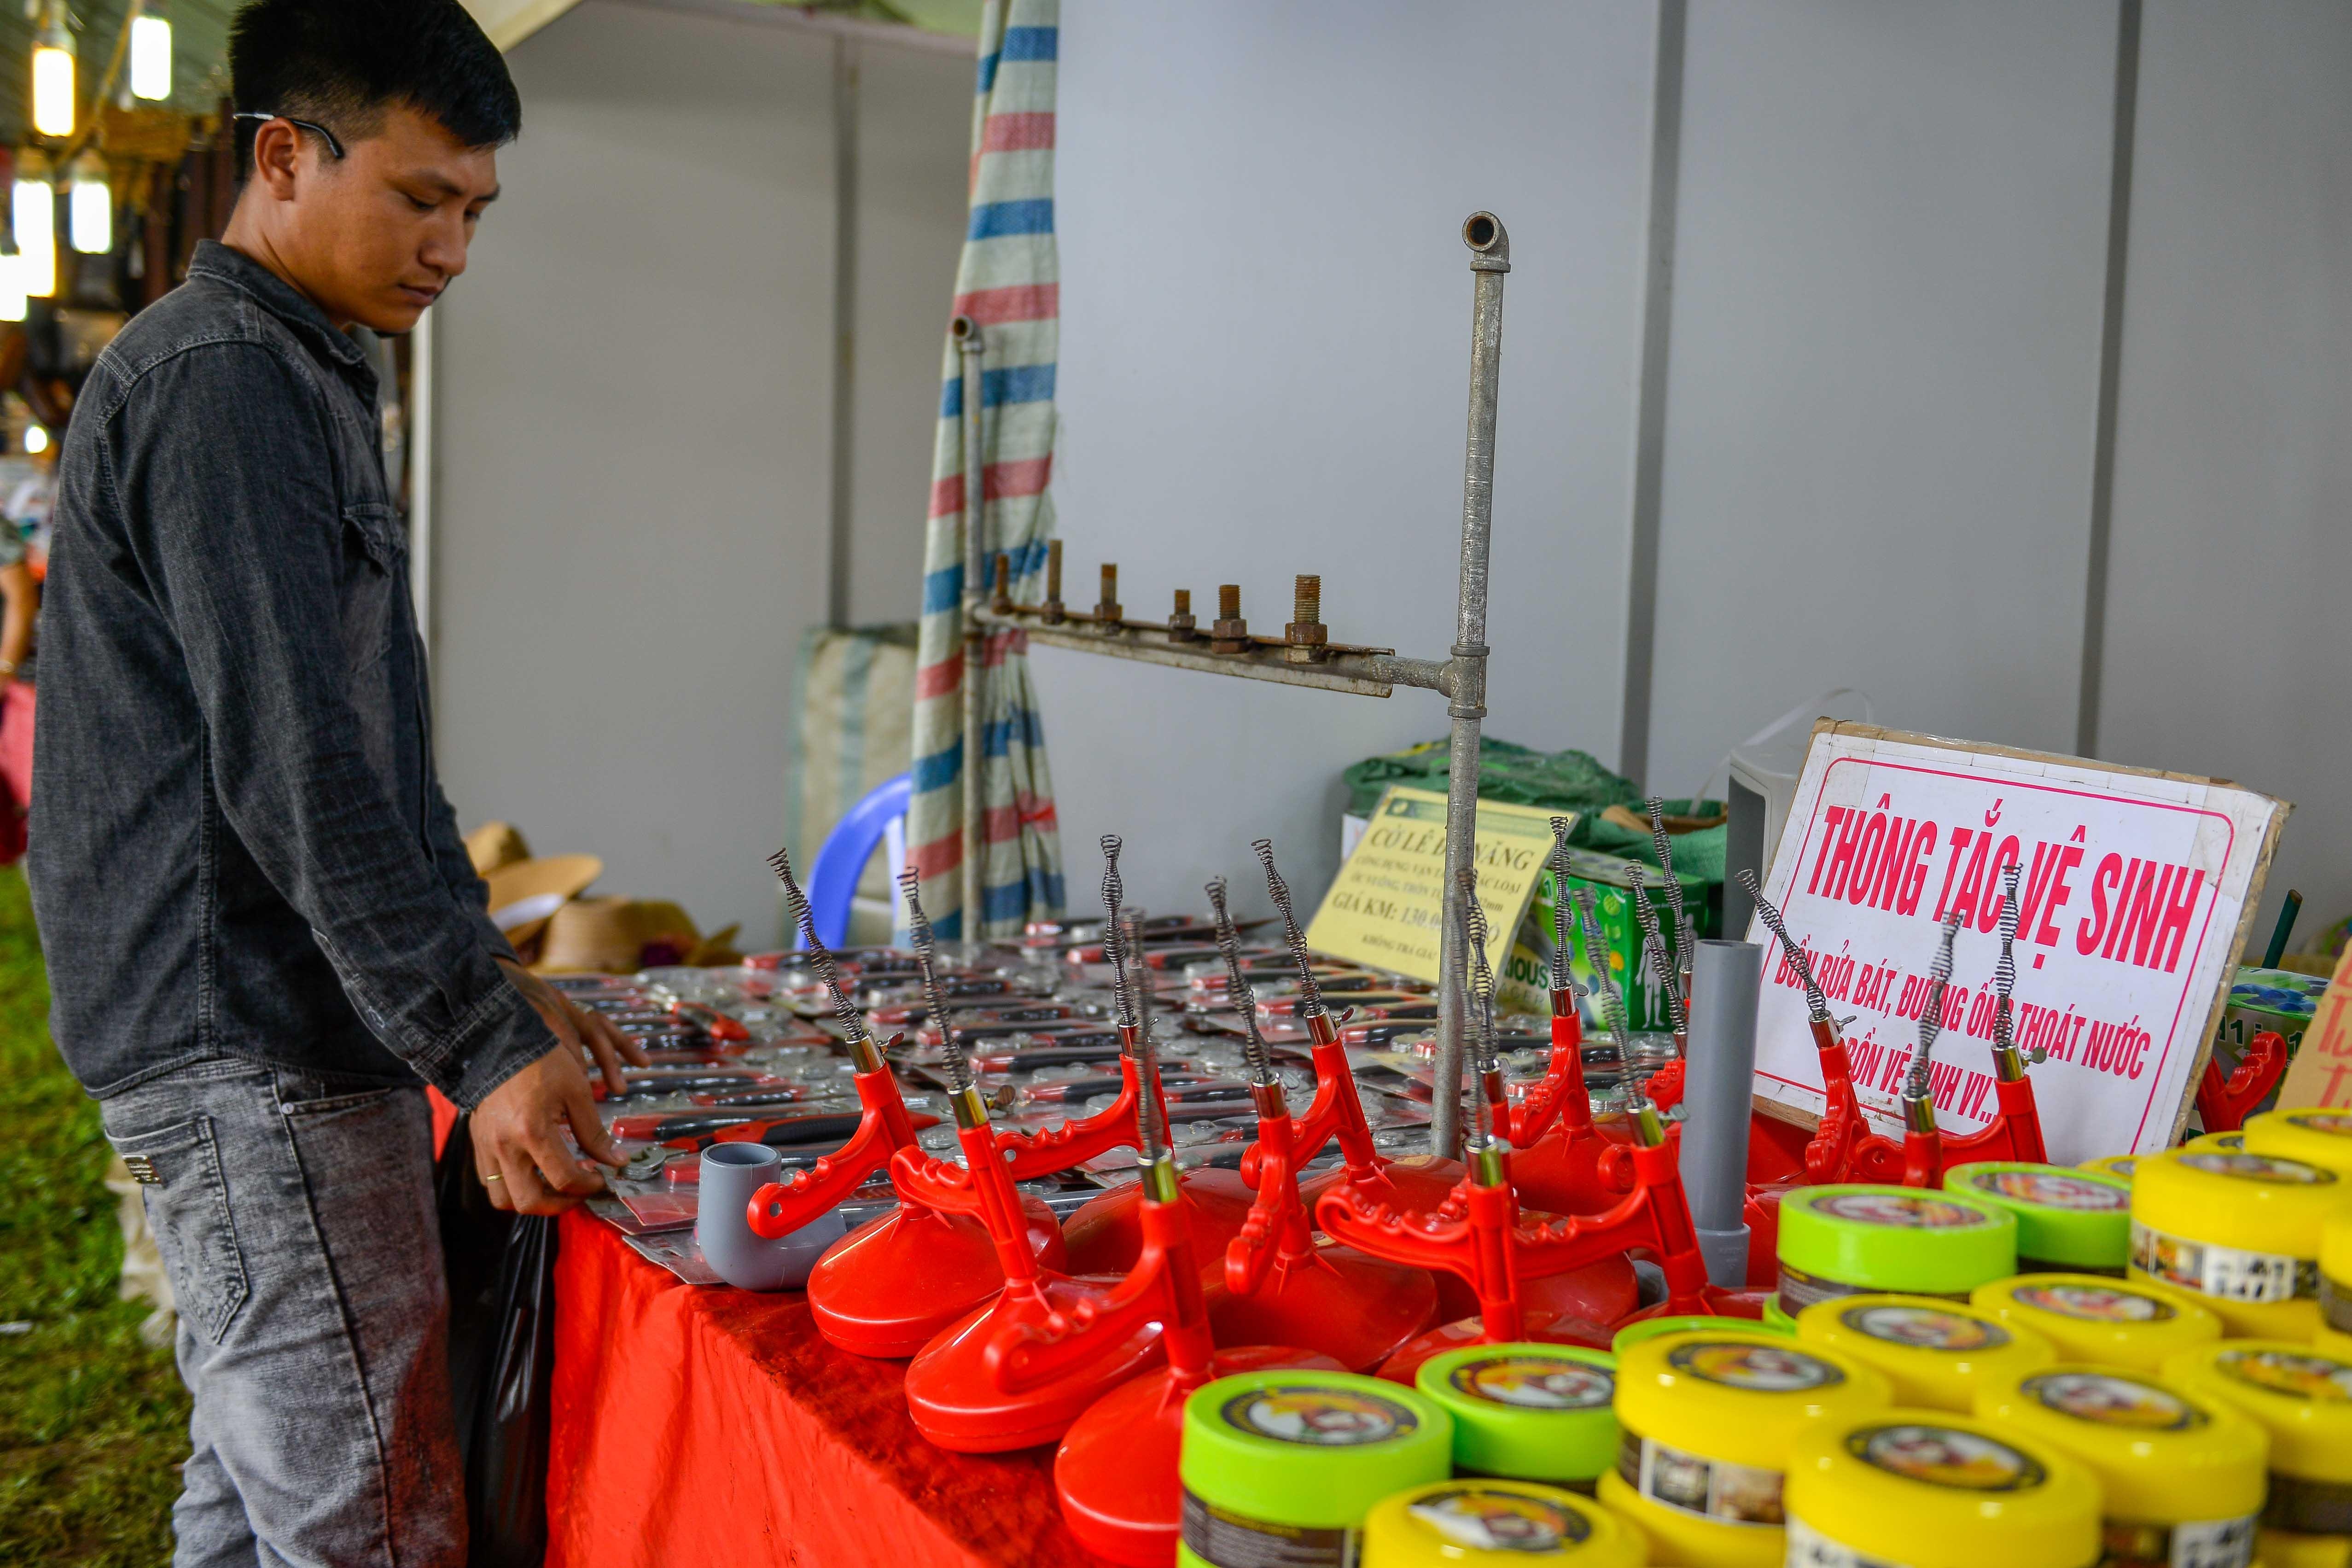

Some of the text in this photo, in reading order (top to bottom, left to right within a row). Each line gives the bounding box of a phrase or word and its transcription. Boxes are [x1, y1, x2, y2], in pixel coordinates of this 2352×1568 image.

[1807, 793, 2206, 973] THÔNG TẮC VỆ SINH
[1816, 939, 1856, 1002] RỬA
[1851, 958, 1898, 1019] BÁT,
[2014, 1003, 2086, 1062] THOÁT
[2081, 1015, 2151, 1080] NƯỚC
[1879, 1043, 1912, 1105] VỆ
